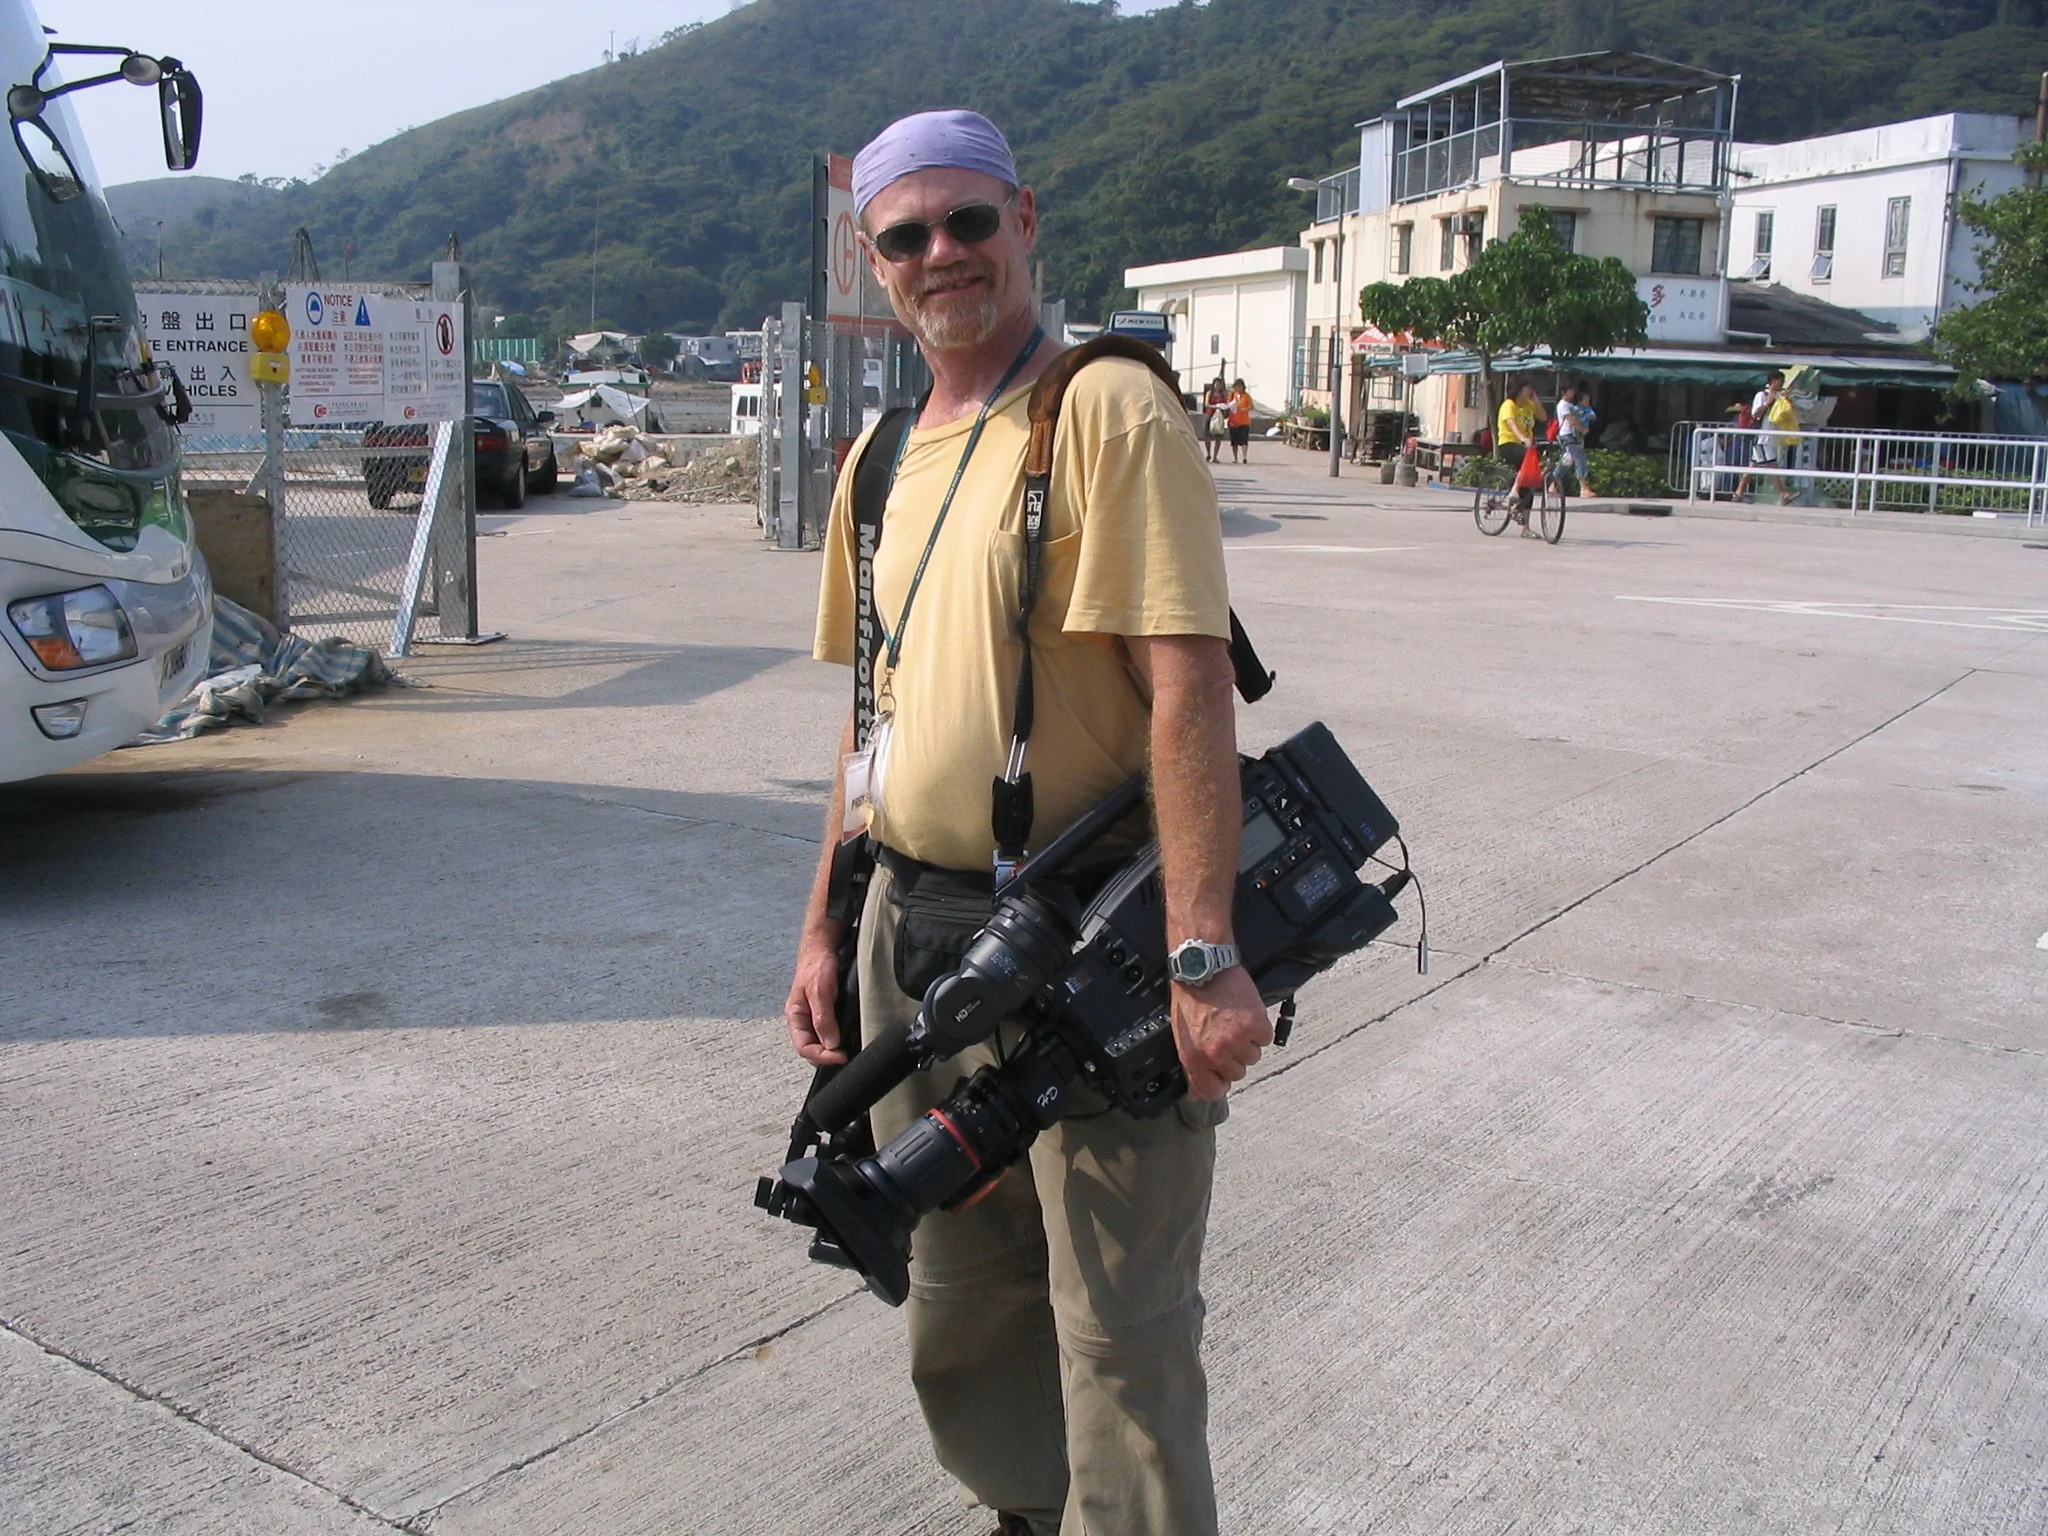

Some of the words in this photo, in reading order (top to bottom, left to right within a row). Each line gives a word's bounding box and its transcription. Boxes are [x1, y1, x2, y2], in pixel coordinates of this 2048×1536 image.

[323, 294, 352, 307] NOTICE
[1650, 284, 1666, 308] 多
[148, 340, 161, 351] E
[167, 340, 248, 352] ENTRANCE
[164, 384, 237, 397] VHICLES
[858, 523, 876, 751] Manfrotto
[1037, 1086, 1058, 1107] HD
